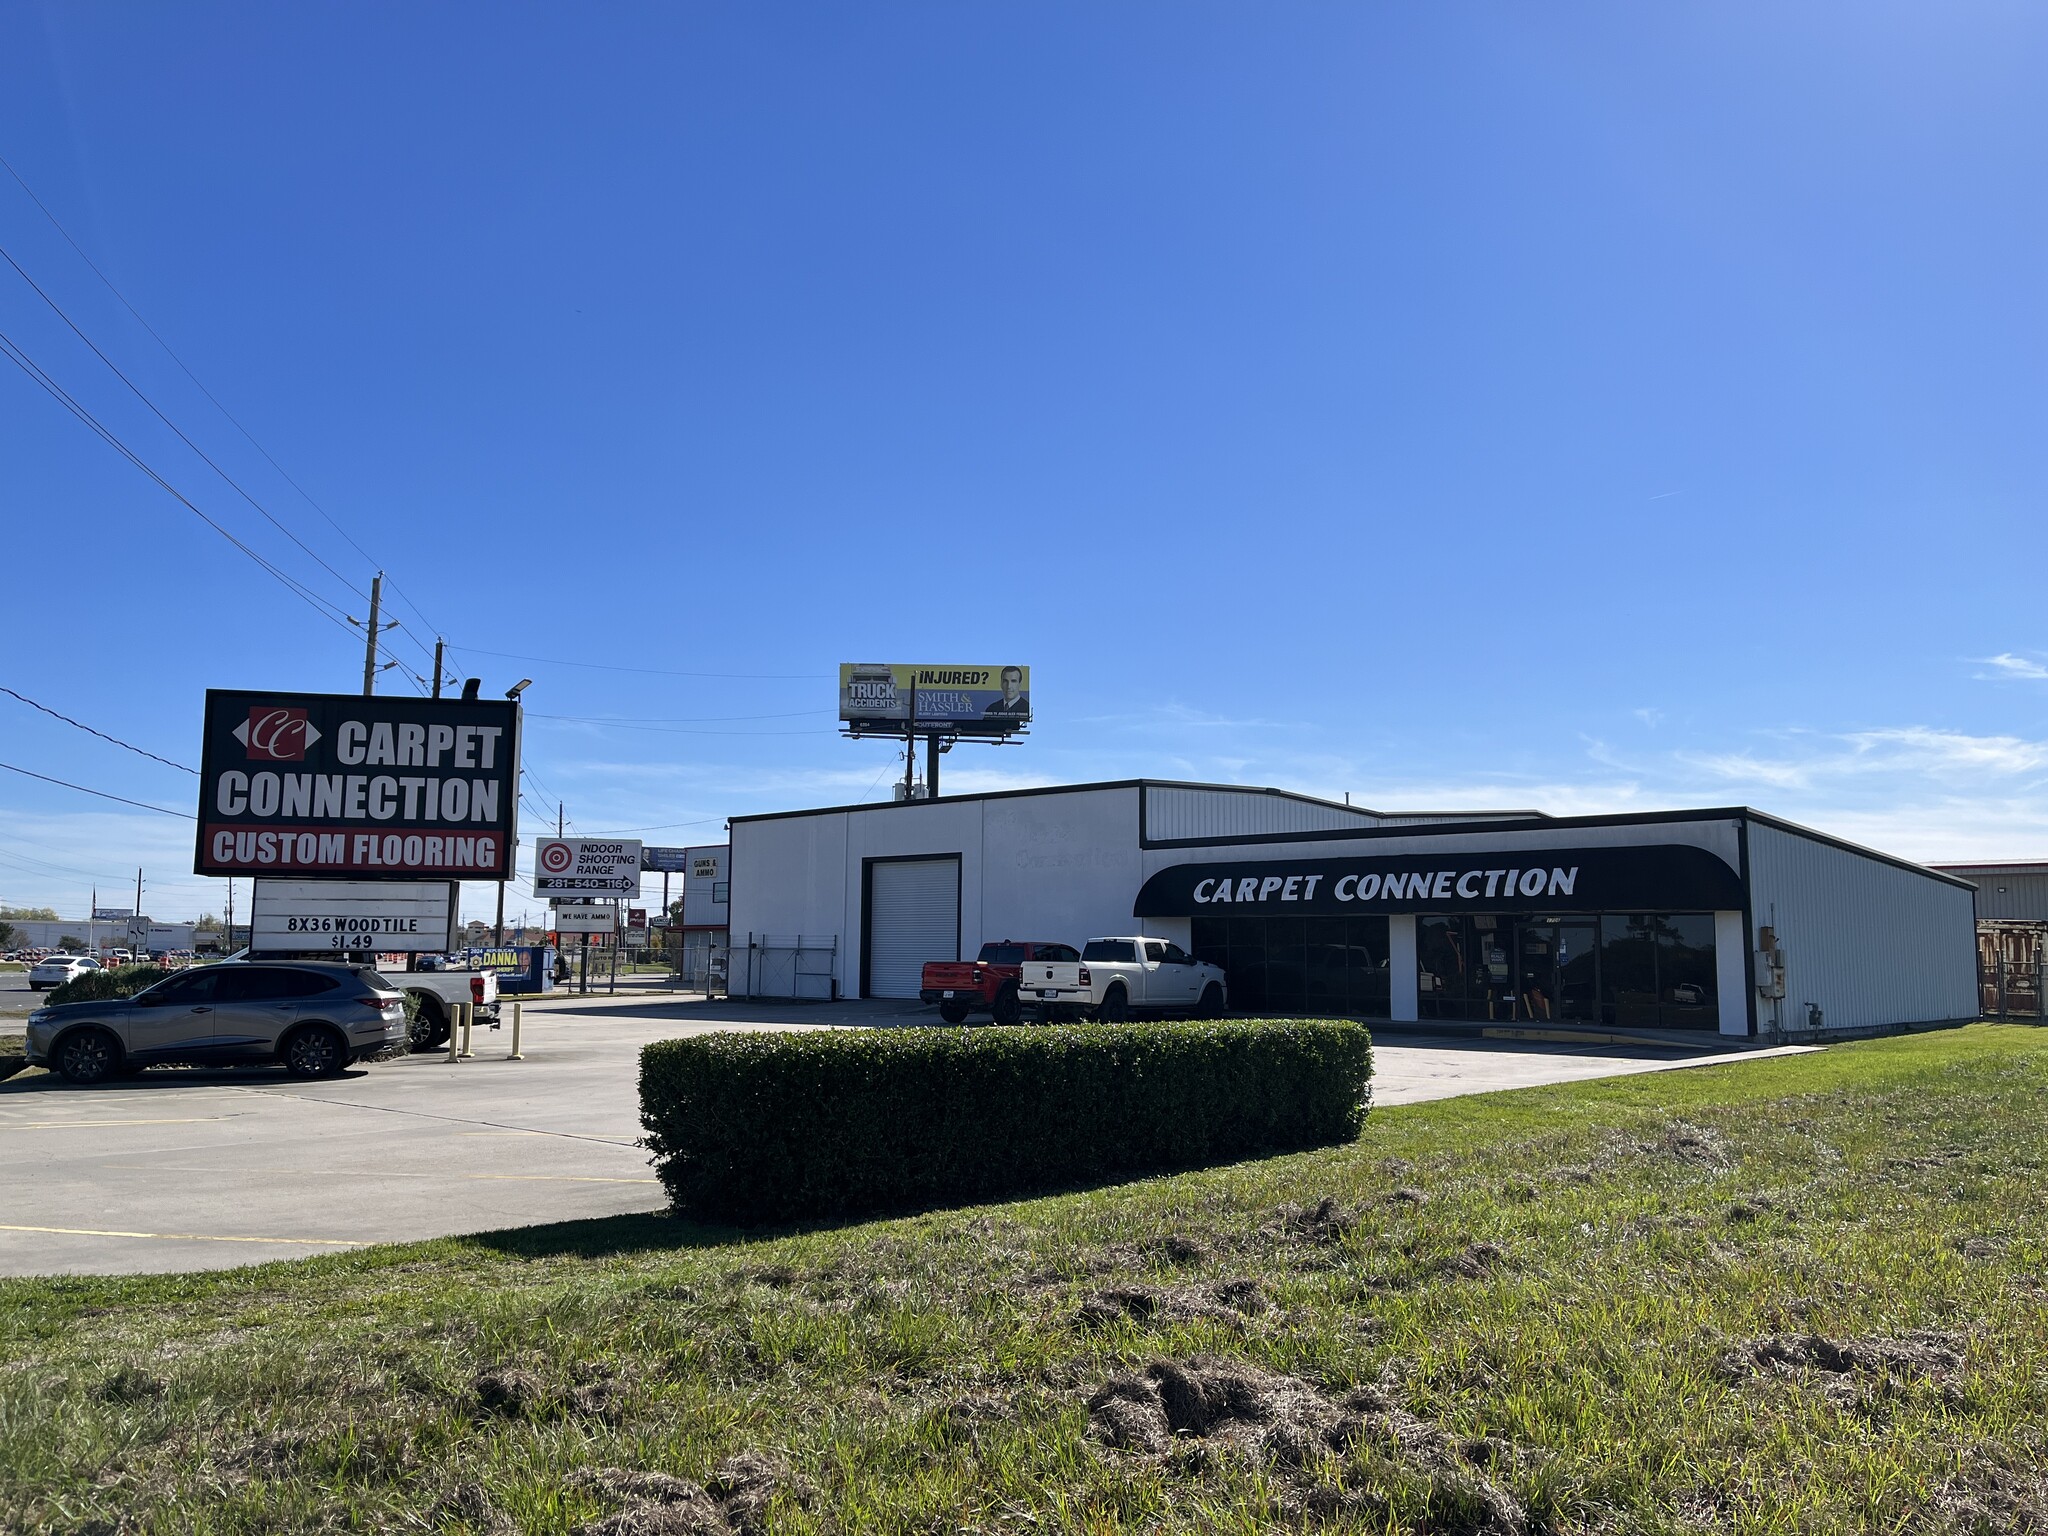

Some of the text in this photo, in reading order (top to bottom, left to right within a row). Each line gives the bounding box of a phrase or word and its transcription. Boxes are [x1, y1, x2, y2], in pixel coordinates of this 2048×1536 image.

[919, 671, 989, 685] INJURED?
[850, 683, 896, 699] TRUCK
[918, 692, 973, 703] SMITH &
[849, 699, 896, 709] ACCIDENTS
[918, 701, 974, 713] HASSLER
[337, 720, 502, 769] CARPET
[217, 770, 499, 822] CONNECTION
[213, 831, 495, 868] CUSTOM FLOORING
[580, 844, 622, 854] INDOOR
[578, 854, 635, 865] SHOOTING
[694, 859, 710, 868] GUNS
[712, 859, 717, 867] &
[576, 865, 615, 875] RANGE
[696, 868, 714, 877] AMMO
[547, 878, 631, 889] 281-540-1160
[1193, 867, 1579, 903] CARPET CONNECTION
[288, 918, 331, 931] 8X36
[331, 935, 373, 949] $1.49
[483, 952, 518, 965] DANNA
